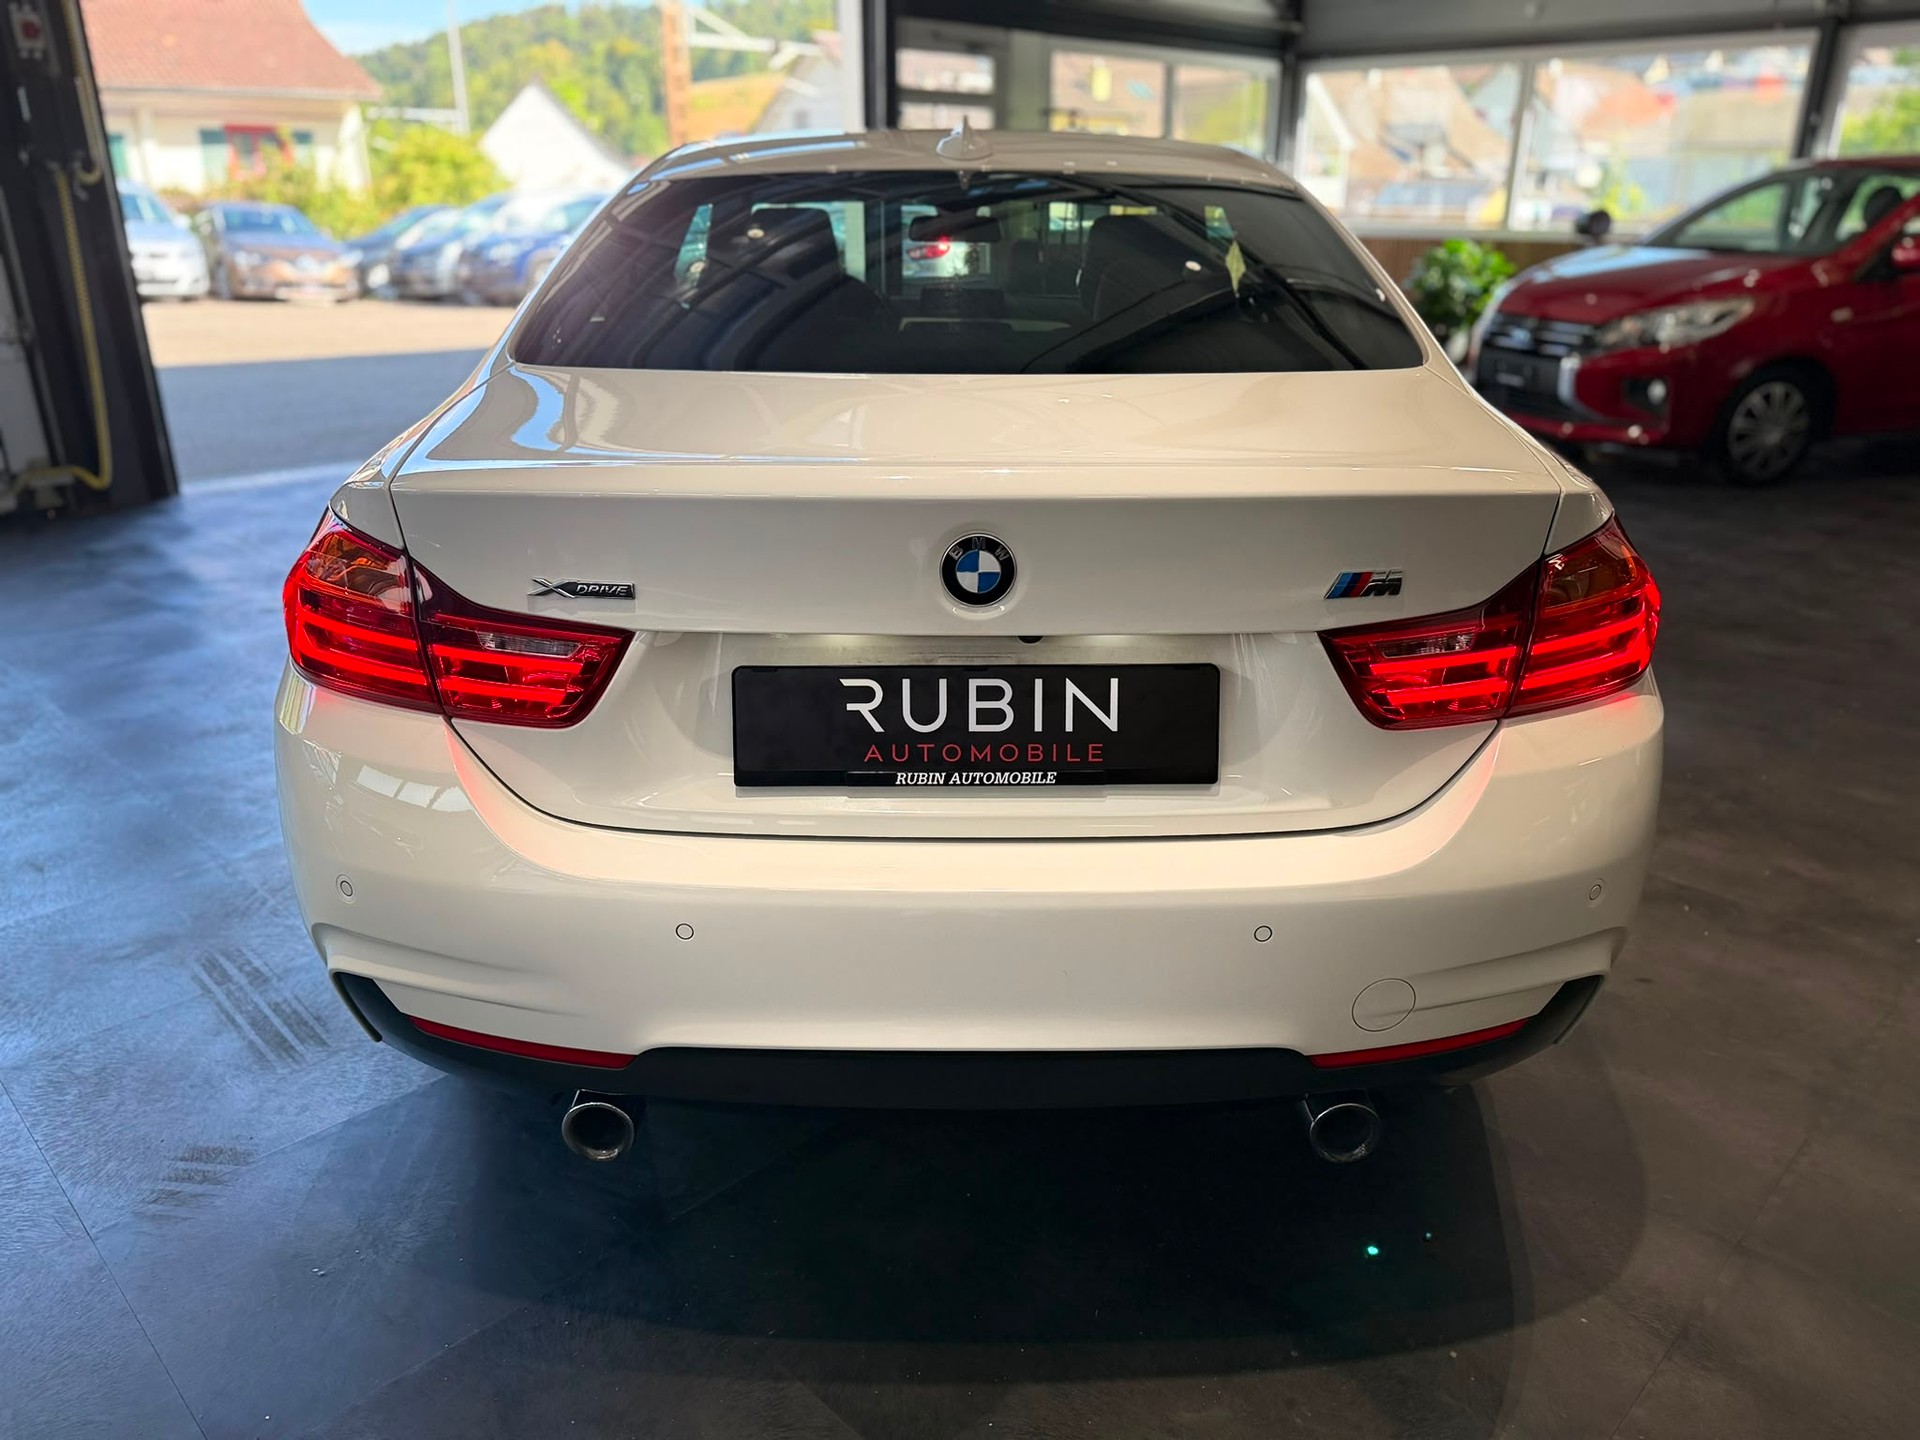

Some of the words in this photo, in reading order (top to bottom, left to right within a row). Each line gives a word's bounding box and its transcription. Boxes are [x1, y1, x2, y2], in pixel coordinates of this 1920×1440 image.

[948, 536, 1011, 561] BMW
[839, 677, 1119, 733] RUBIN
[863, 743, 1104, 763] AUTOMOBILE
[895, 771, 946, 786] RUBIN
[948, 771, 1058, 786] AUTOMOBILE
